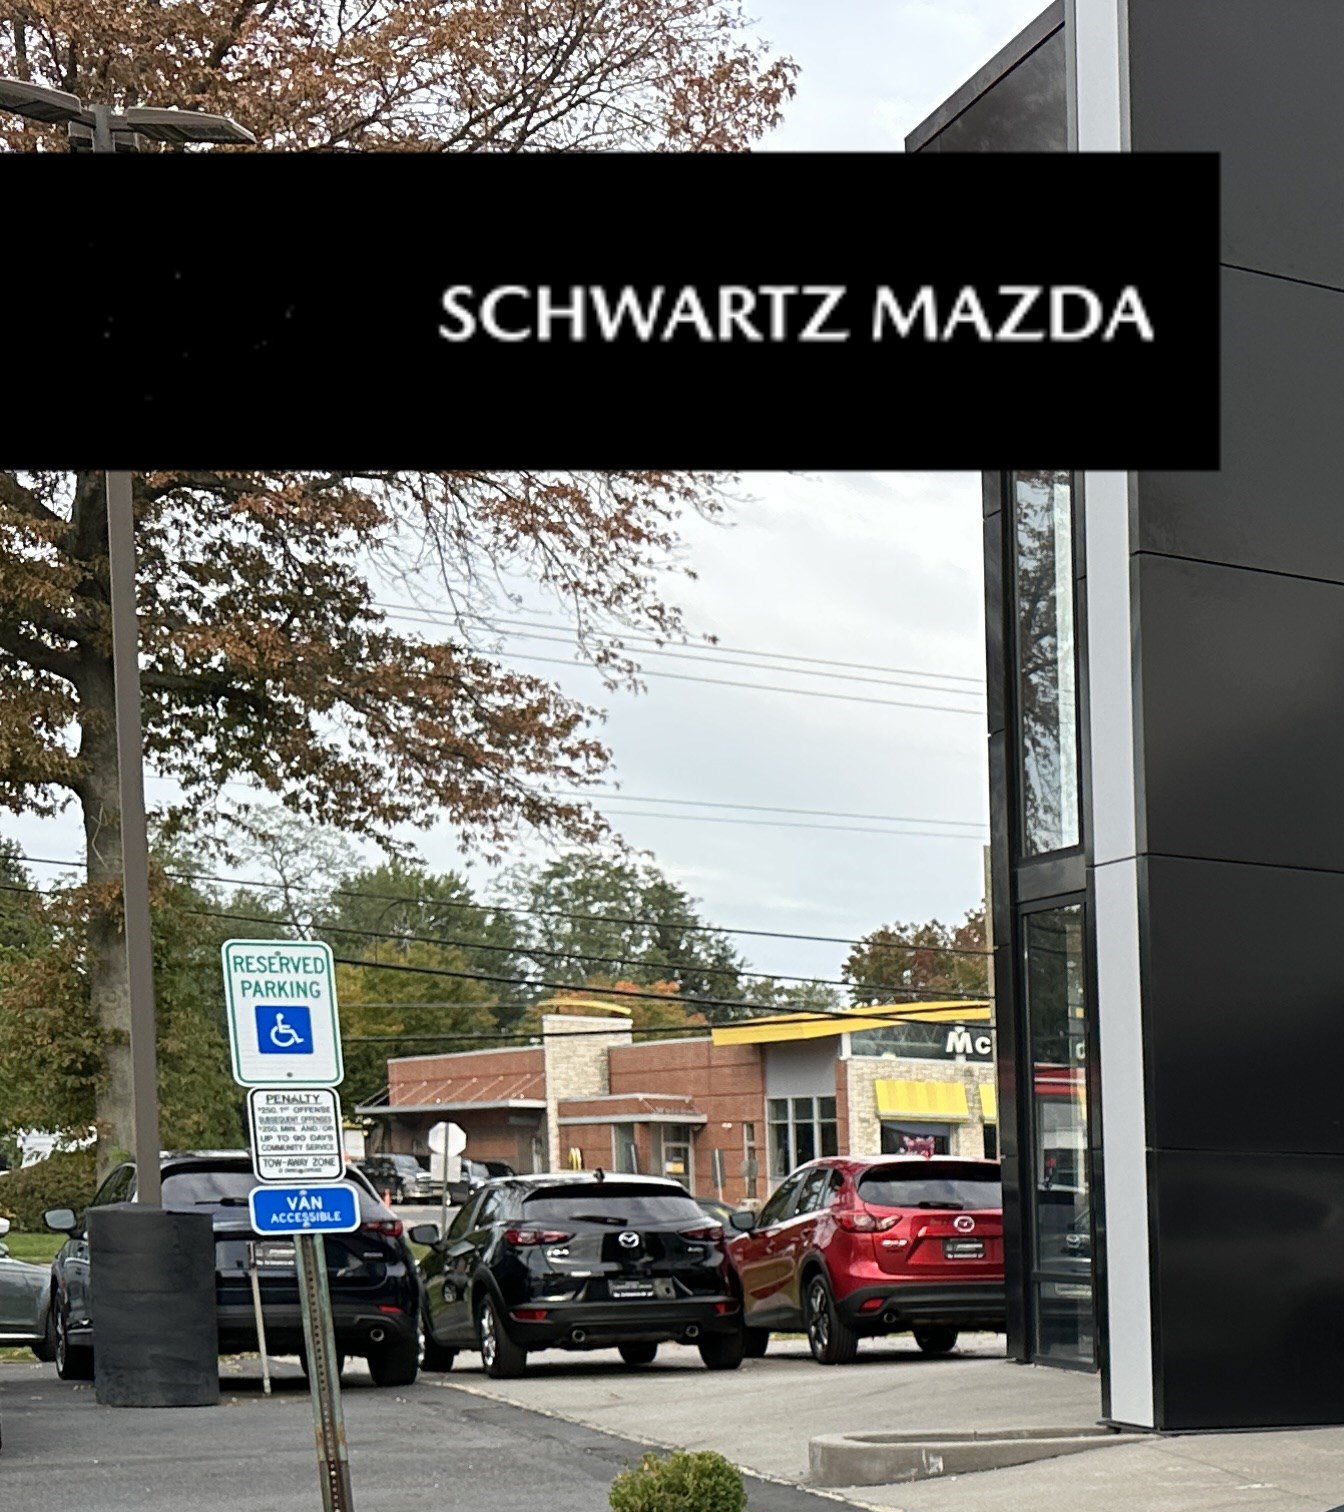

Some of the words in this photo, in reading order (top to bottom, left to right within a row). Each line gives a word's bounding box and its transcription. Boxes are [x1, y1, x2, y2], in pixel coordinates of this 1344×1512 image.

[232, 955, 325, 975] RESERVED
[240, 980, 321, 999] PARKING
[265, 1094, 321, 1104] PENALTY
[292, 1106, 331, 1114] OFFENSE
[276, 1134, 290, 1142] TO
[309, 1134, 334, 1142] DAYS
[260, 1144, 303, 1152] COMMUNITY
[305, 1143, 335, 1151] SERVICE
[312, 1157, 336, 1167] ZONE
[286, 1195, 323, 1211] VAN
[270, 1211, 342, 1224] ACCESSIBLE
